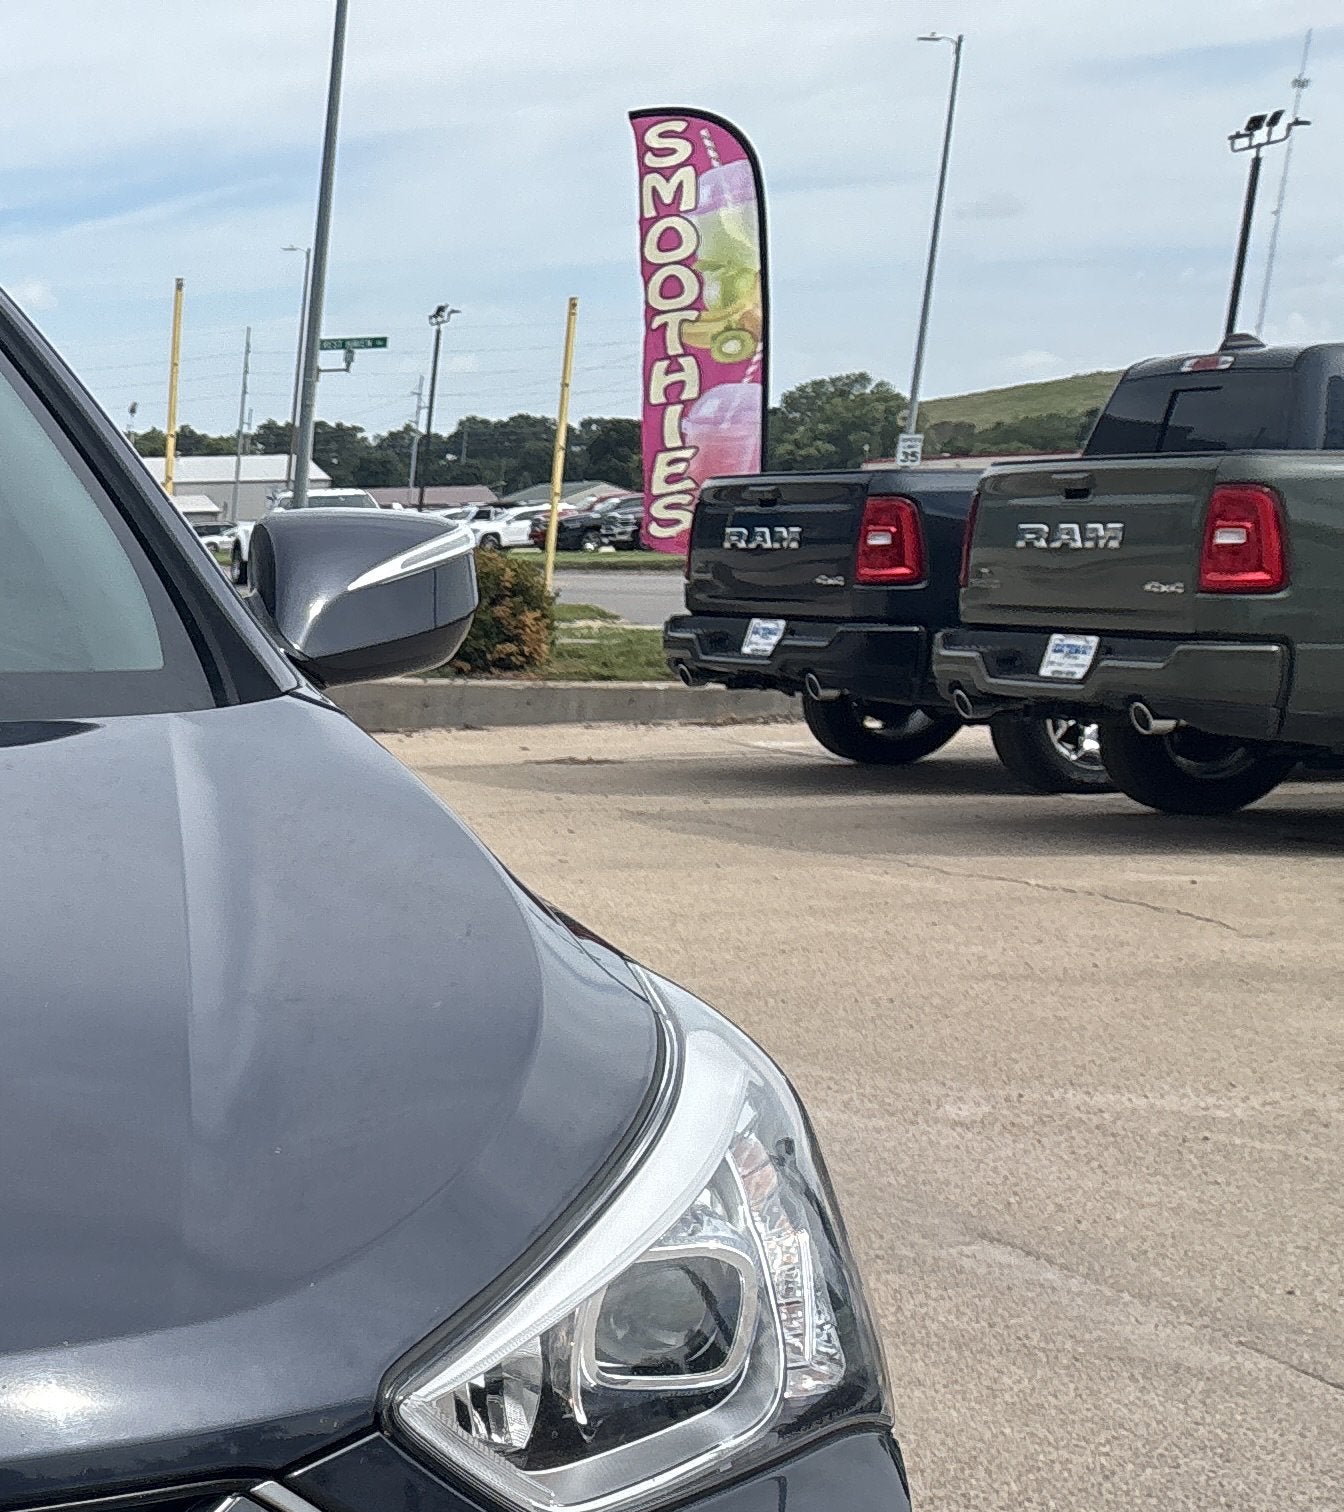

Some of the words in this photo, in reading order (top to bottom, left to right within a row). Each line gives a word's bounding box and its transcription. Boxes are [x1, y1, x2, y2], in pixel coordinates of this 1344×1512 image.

[643, 119, 701, 539] SMOOTHIES
[900, 450, 919, 463] 35
[723, 526, 803, 549] RAM
[1015, 523, 1125, 549] RAM
